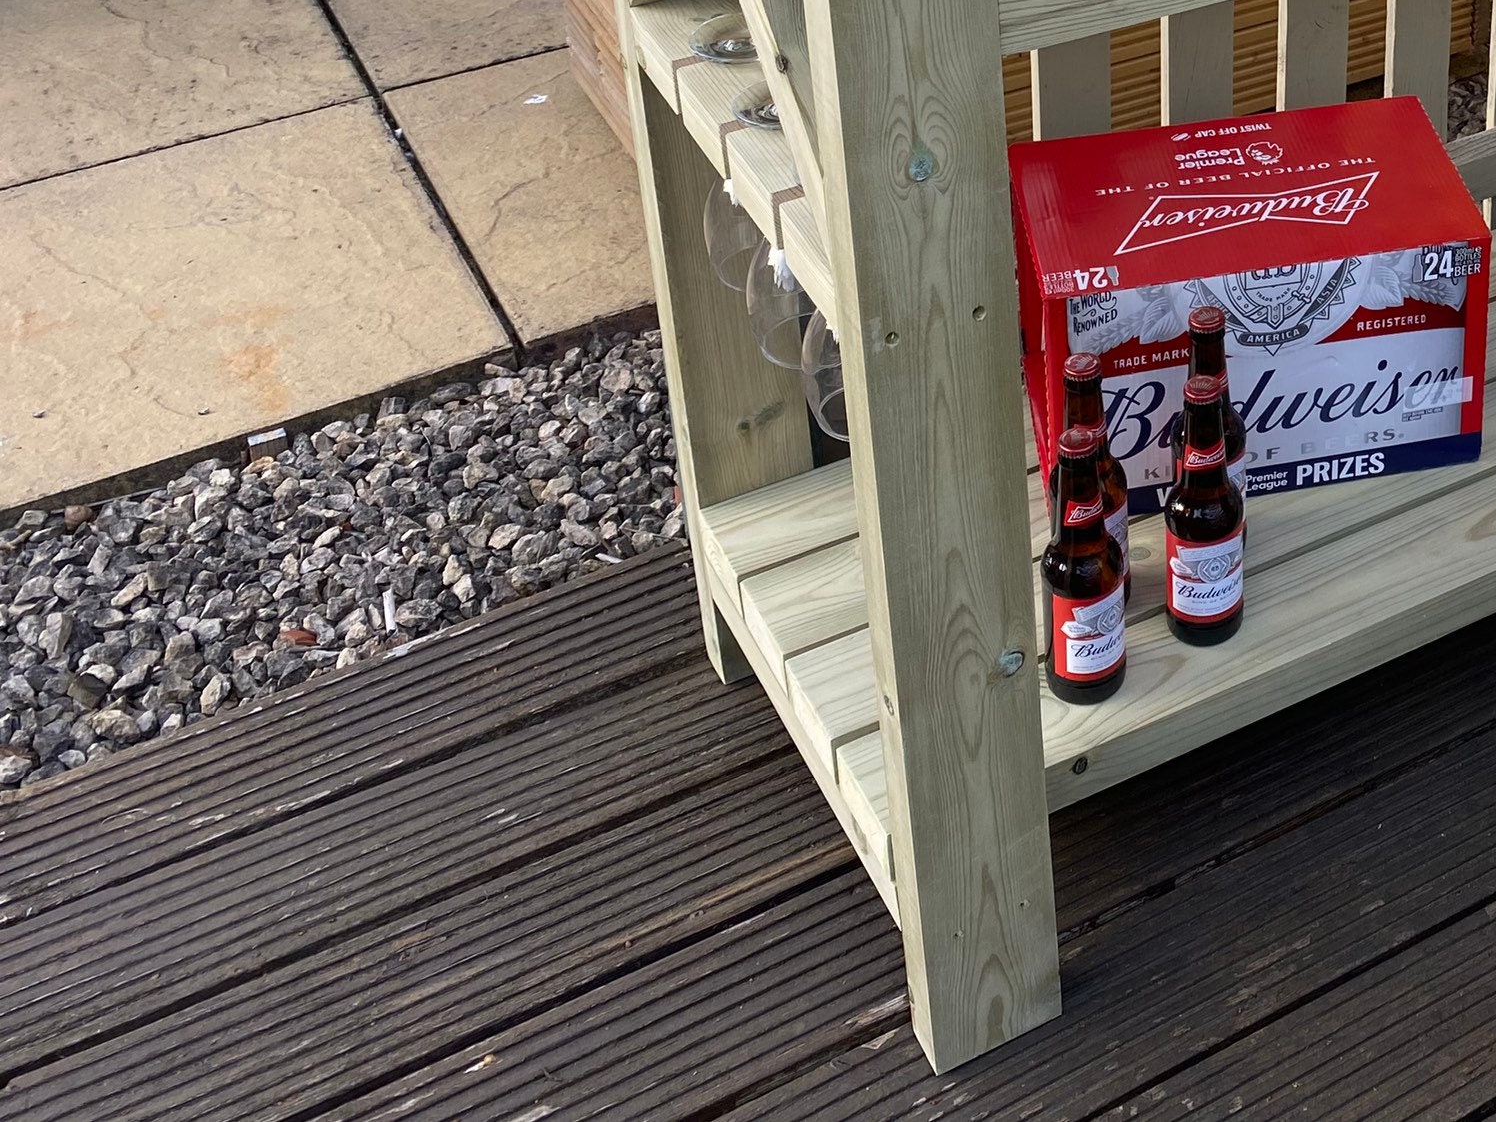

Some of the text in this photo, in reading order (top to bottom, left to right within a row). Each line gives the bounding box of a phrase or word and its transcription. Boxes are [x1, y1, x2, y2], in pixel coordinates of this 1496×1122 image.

[1195, 122, 1272, 138] TWIST OFF CAP
[1174, 148, 1241, 162] League
[1178, 156, 1245, 170] Premier
[1095, 157, 1376, 196] THE OFFICIAL BEER OF THE
[1140, 187, 1370, 228] Budweiser
[1424, 250, 1454, 281] 24
[1454, 263, 1481, 277] BEER
[1042, 270, 1072, 283] BEER
[1073, 266, 1108, 291] 24
[1317, 278, 1338, 305] ASIA
[1073, 308, 1118, 336] RENOWNED
[1113, 313, 1427, 369] TRADE MARK REGISTERED
[1246, 328, 1300, 343] AMERICA
[1246, 470, 1289, 484] Premier
[1296, 452, 1386, 486] PRIZES
[1246, 478, 1289, 491] League
